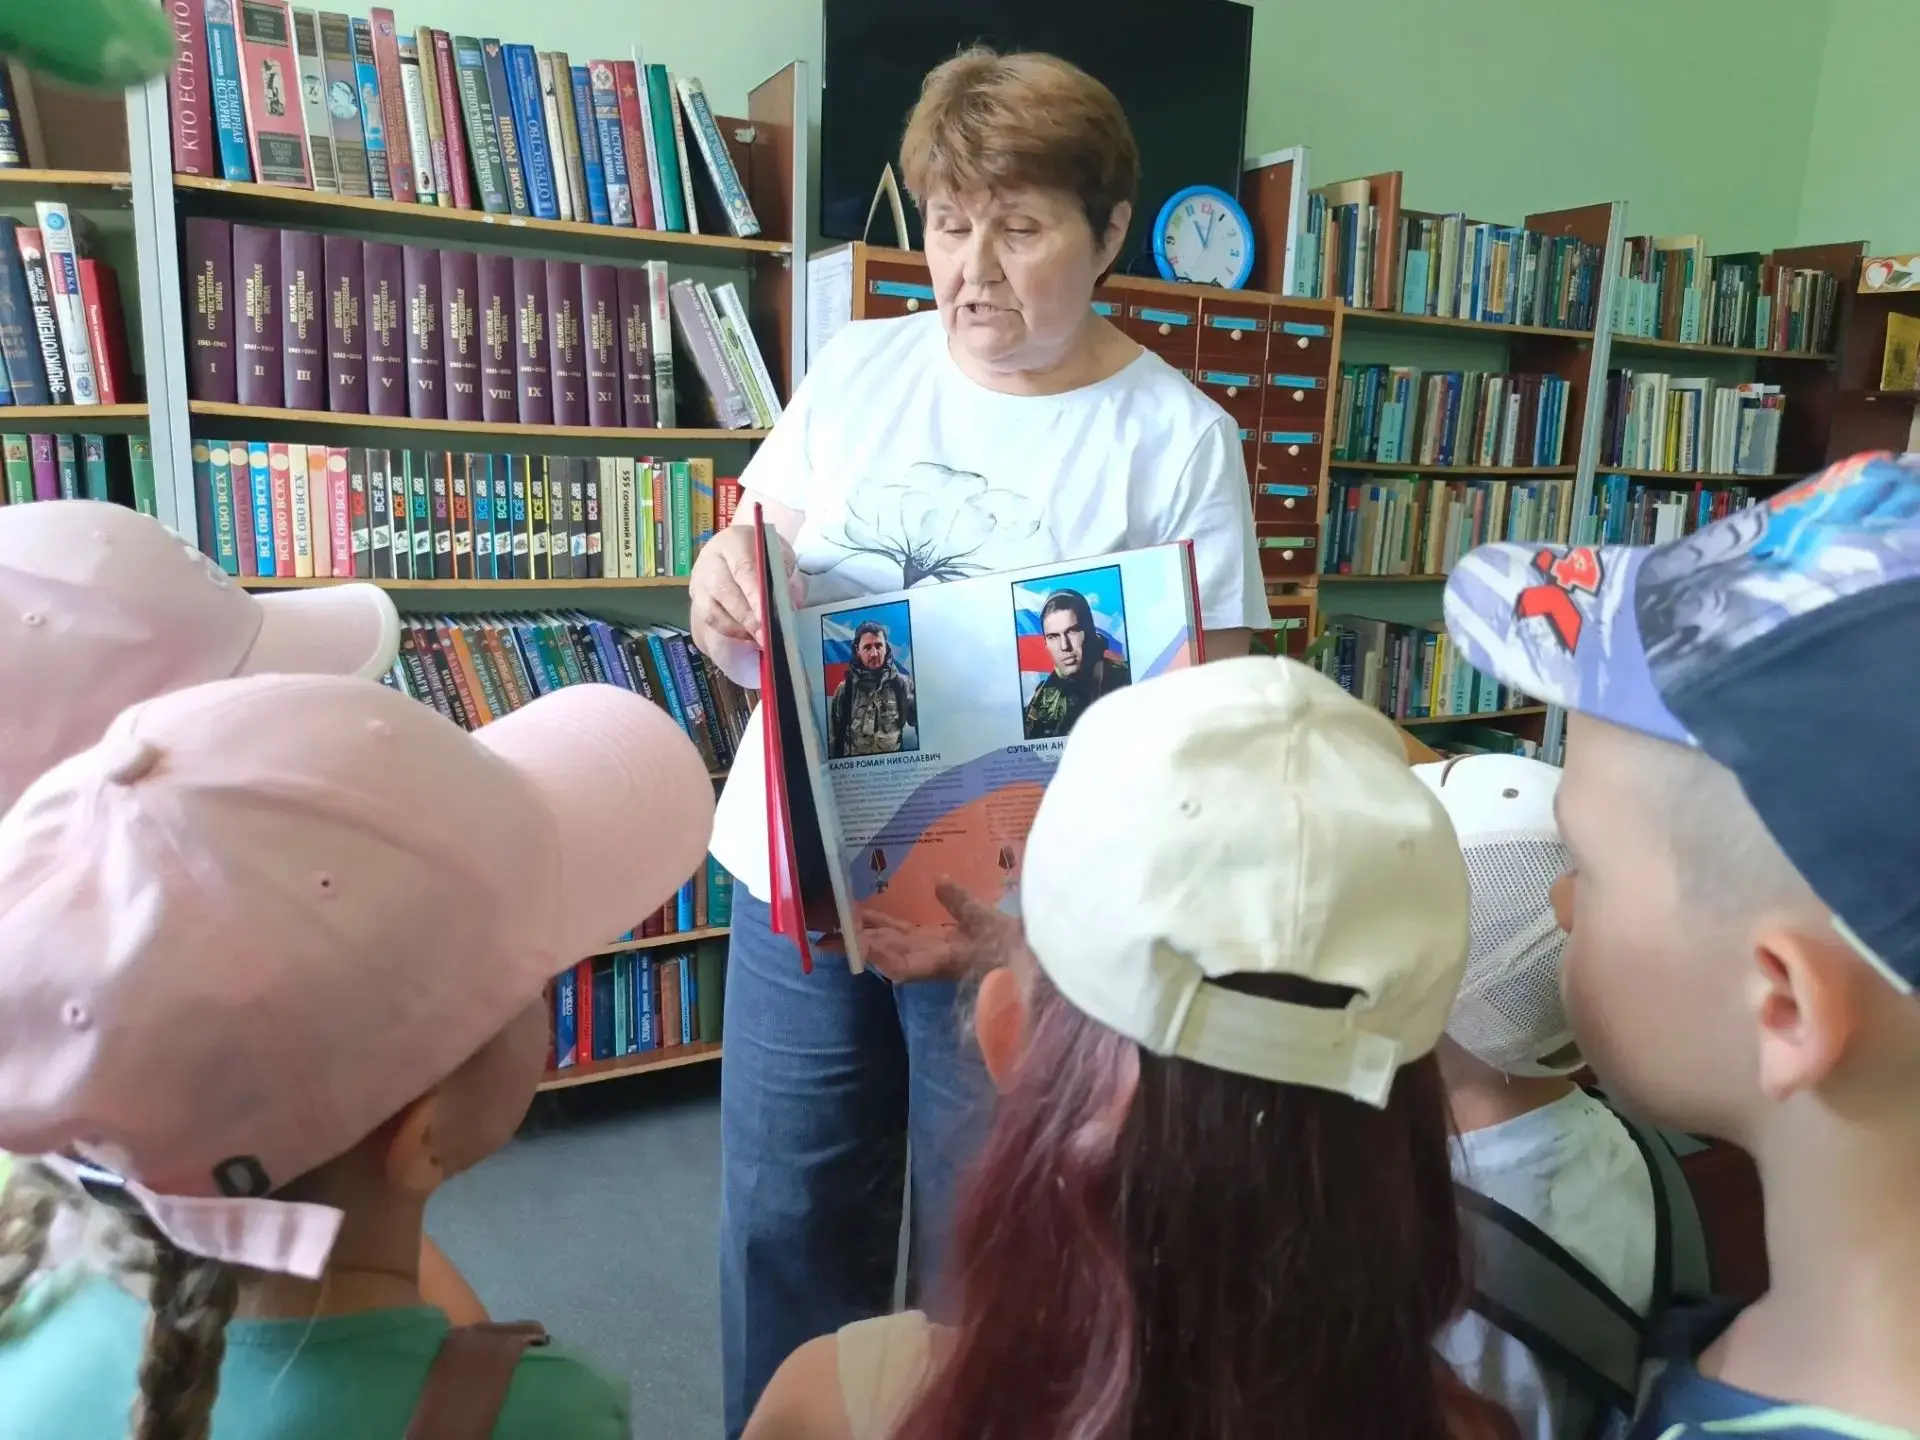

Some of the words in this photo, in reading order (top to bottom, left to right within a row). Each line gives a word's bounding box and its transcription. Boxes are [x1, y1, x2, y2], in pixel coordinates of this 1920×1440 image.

[173, 2, 193, 44] КТО
[176, 51, 196, 103] ЕСТЬ
[217, 78, 232, 130] ИСТОРИЯ
[228, 79, 245, 144] ВСЕМИРНАЯ
[462, 70, 486, 147] ЭНЦИКЛОПЕДИЯ
[180, 110, 198, 150] КТО
[481, 103, 500, 164] ОРУЖИЯ
[499, 116, 516, 161] РОССИИ
[529, 120, 550, 200] ОТЕЧЕСТВО
[612, 126, 626, 176] ИСТОРИЯ
[478, 148, 496, 192] БОЛЬШАЯ
[509, 167, 525, 210] ОРУЖИЕ
[1202, 202, 1213, 214] 12
[1166, 236, 1176, 246] 9
[64, 256, 76, 290] НАУКА
[198, 275, 206, 314] ВЕЛИКАЯ
[206, 260, 216, 330] ОТЕЧЕСТВЕННАЯ
[215, 281, 223, 311] ВОЙНА
[246, 278, 254, 316] ВЕЛИКАЯ
[254, 264, 264, 333] ОТЕЧЕСТВЕННАЯ
[263, 284, 272, 314] ВОЙНА
[289, 284, 297, 322] ВЕЛИКАЯ
[297, 270, 306, 339] ОТЕЧЕСТВЕННАЯ
[305, 291, 314, 320] ВОЙНА
[334, 290, 342, 328] ВЕЛИКАЯ
[342, 276, 351, 344] ОТЕЧЕСТВЕННАЯ
[373, 294, 381, 331] ВЕЛИКАЯ
[380, 280, 390, 346] ОТЕЧЕСТВЕННАЯ
[420, 284, 428, 350] ОТЕЧЕСТВЕННАЯ
[458, 288, 467, 354] ОТЕЧЕСТВЕННАЯ
[494, 295, 502, 360] ОТЕЧЕСТВЕННАЯ
[528, 294, 536, 358] ОТЕЧЕСТВЕННАЯ
[34, 305, 66, 394] ЭНЦИКЛОПЕДИЯ
[197, 339, 227, 348] 1941-1945
[210, 362, 216, 374] I
[254, 364, 264, 376] II
[297, 370, 312, 380] III
[340, 374, 355, 384] IV
[381, 378, 392, 388] V
[418, 380, 434, 390] VI
[455, 383, 473, 393] VII
[489, 390, 512, 400] VIII
[528, 388, 544, 397] IX
[566, 392, 576, 401] X
[598, 392, 612, 402] XI
[633, 394, 650, 403] XII
[216, 472, 227, 504] ВСЕХ
[256, 474, 266, 505] ВСЕХ
[275, 477, 286, 508] ВСЕХ
[294, 474, 305, 504] ВСЕХ
[622, 470, 631, 487] 555
[334, 480, 345, 509] ВСЕХ
[219, 506, 230, 531] ОБО
[259, 508, 269, 532] ОБО
[278, 512, 288, 536] ОБО
[297, 507, 306, 532] ОБО
[336, 512, 346, 536] ОБО
[622, 490, 631, 538] СОЧИНЕНИЙ
[624, 539, 630, 550] НА
[406, 654, 429, 694] ДЕНЬГИ
[856, 760, 885, 768] РОМАН
[886, 753, 942, 766] НИКОЛАЕВИЧ
[1006, 744, 1048, 754] СУТЫРИН
